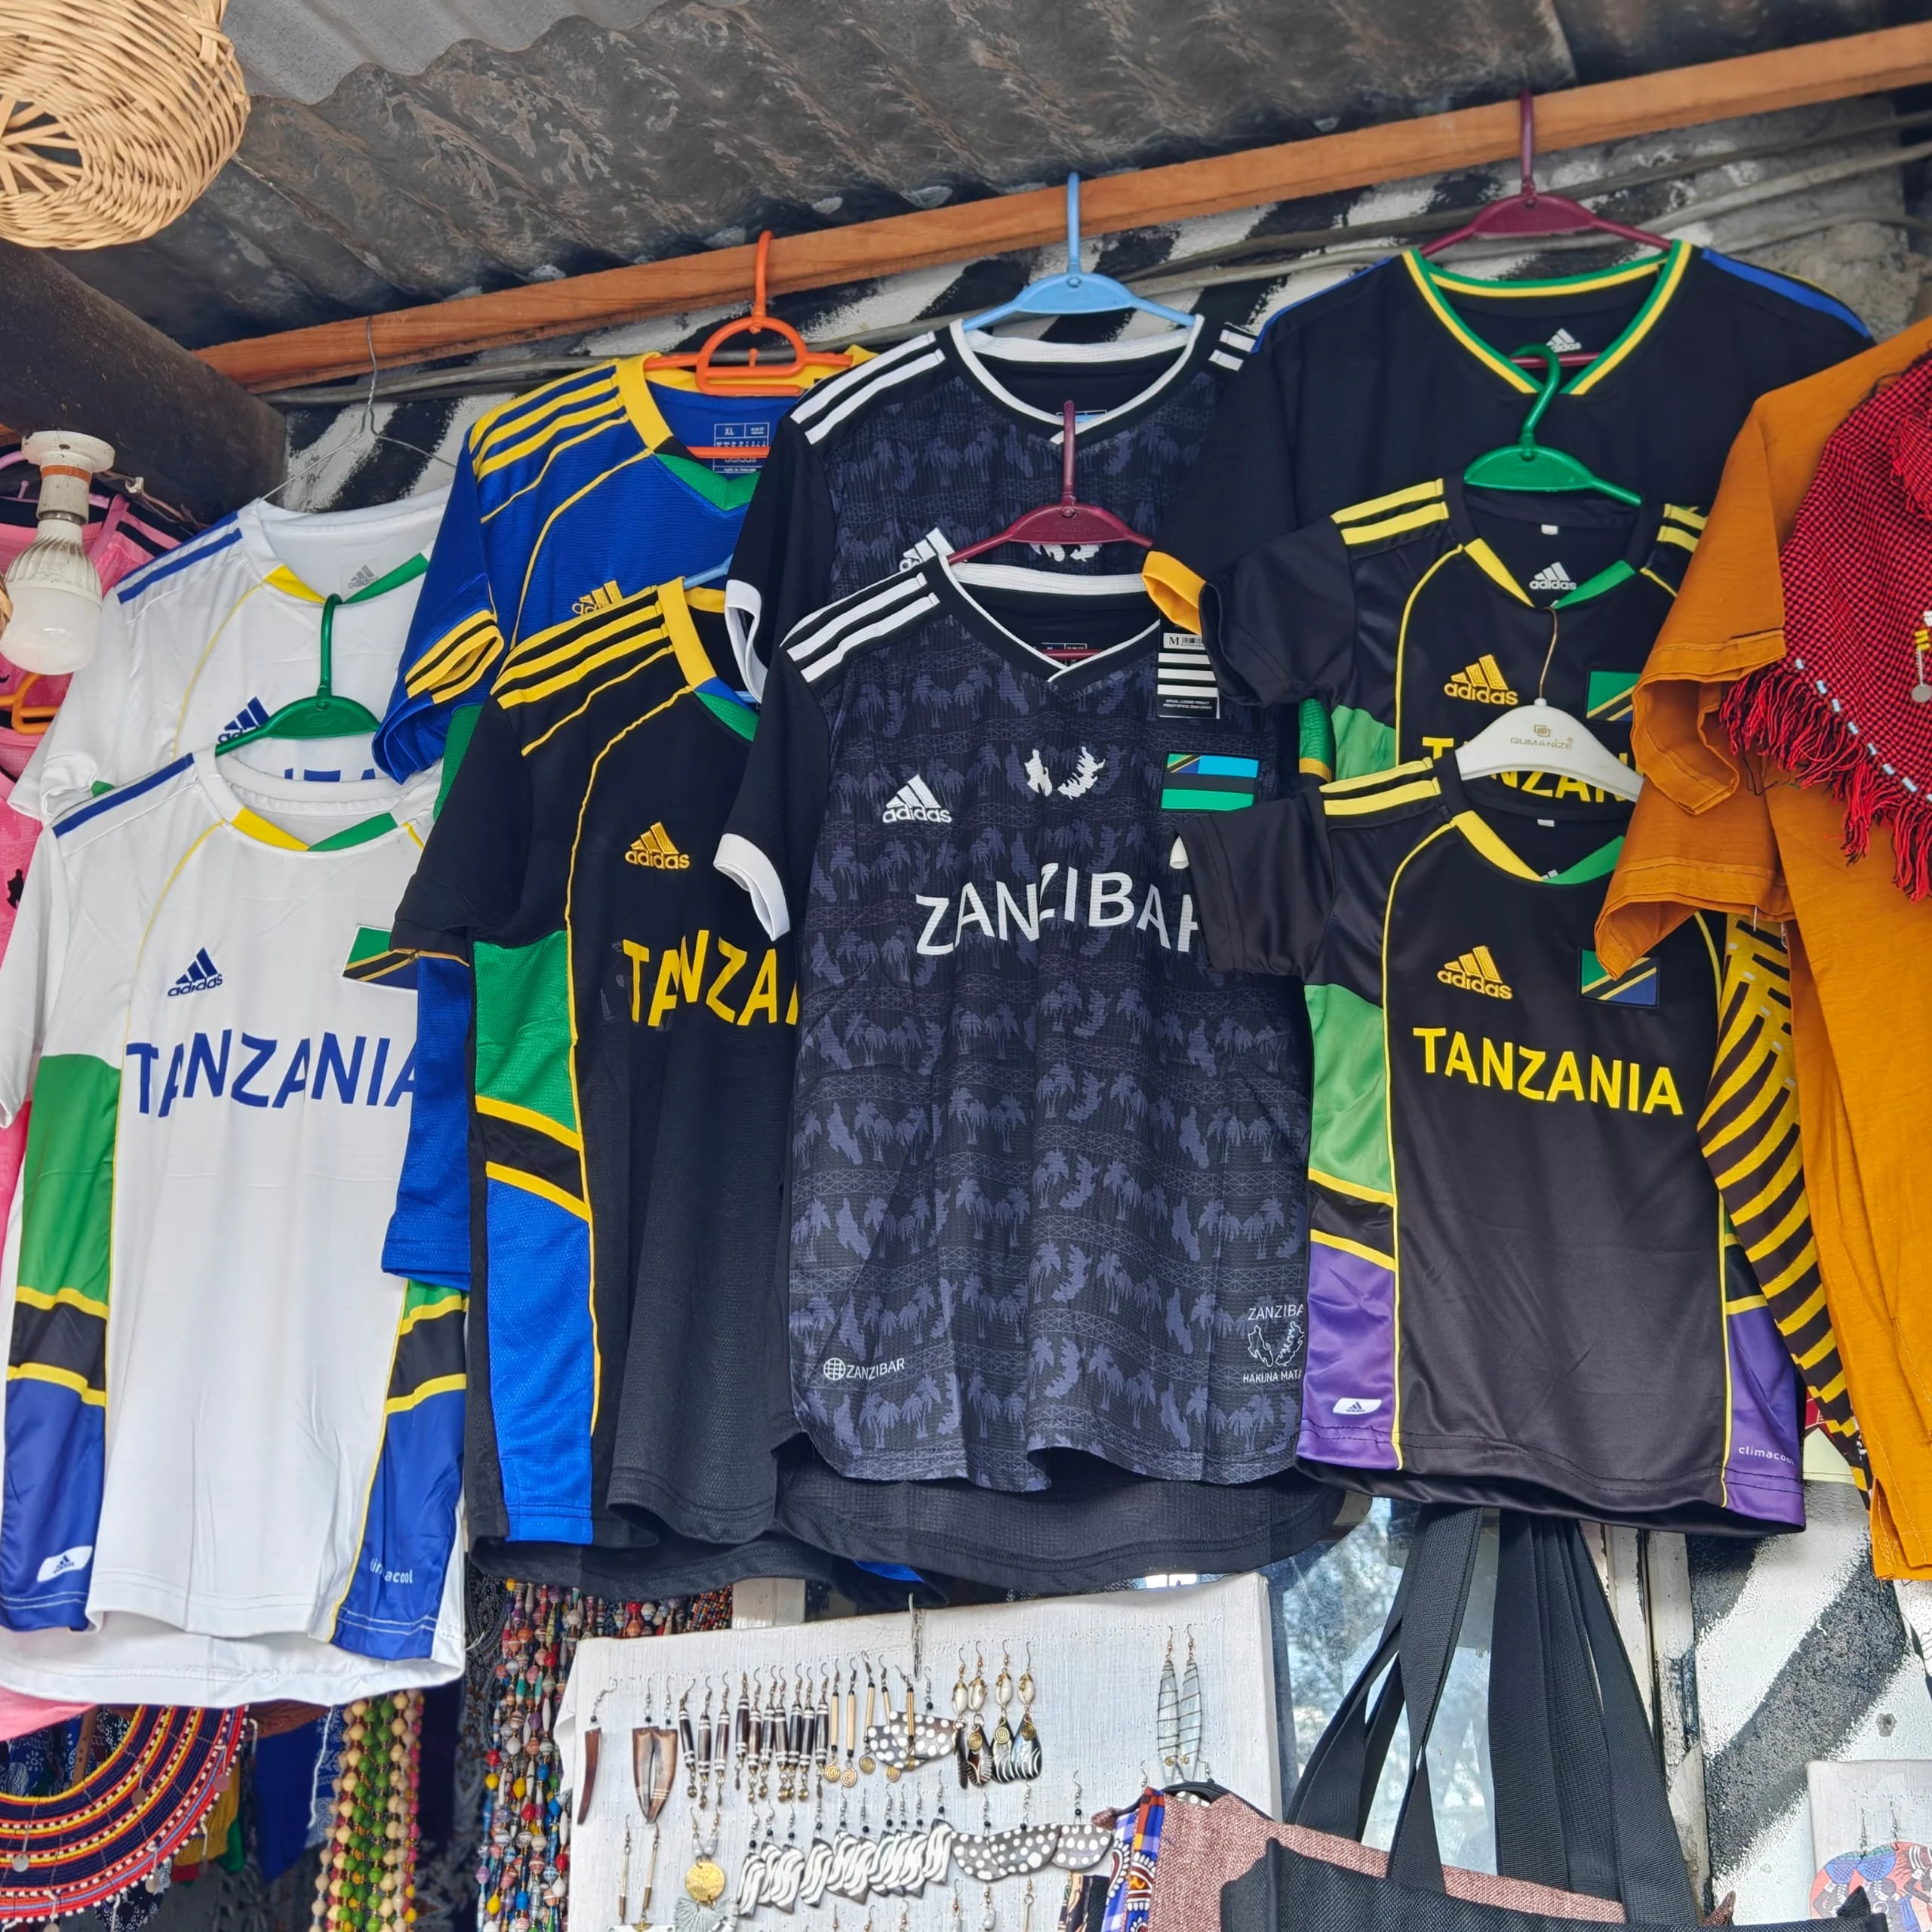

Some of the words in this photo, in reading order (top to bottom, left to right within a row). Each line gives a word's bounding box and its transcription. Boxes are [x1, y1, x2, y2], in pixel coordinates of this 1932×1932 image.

[1549, 342, 1583, 353] didas
[724, 426, 734, 435] XL
[1529, 580, 1577, 590] adidas
[1169, 636, 1180, 646] M
[1444, 682, 1518, 706] adidas
[882, 804, 952, 823] adidas
[624, 850, 691, 869] adidas
[168, 973, 223, 997] adidas
[1437, 970, 1512, 999] adidas
[1413, 1027, 1684, 1115] TANZANIA
[846, 1358, 905, 1380] ZANZIBAR
[1243, 1371, 1279, 1383] HAKUNA
[369, 1558, 414, 1584] limacool
